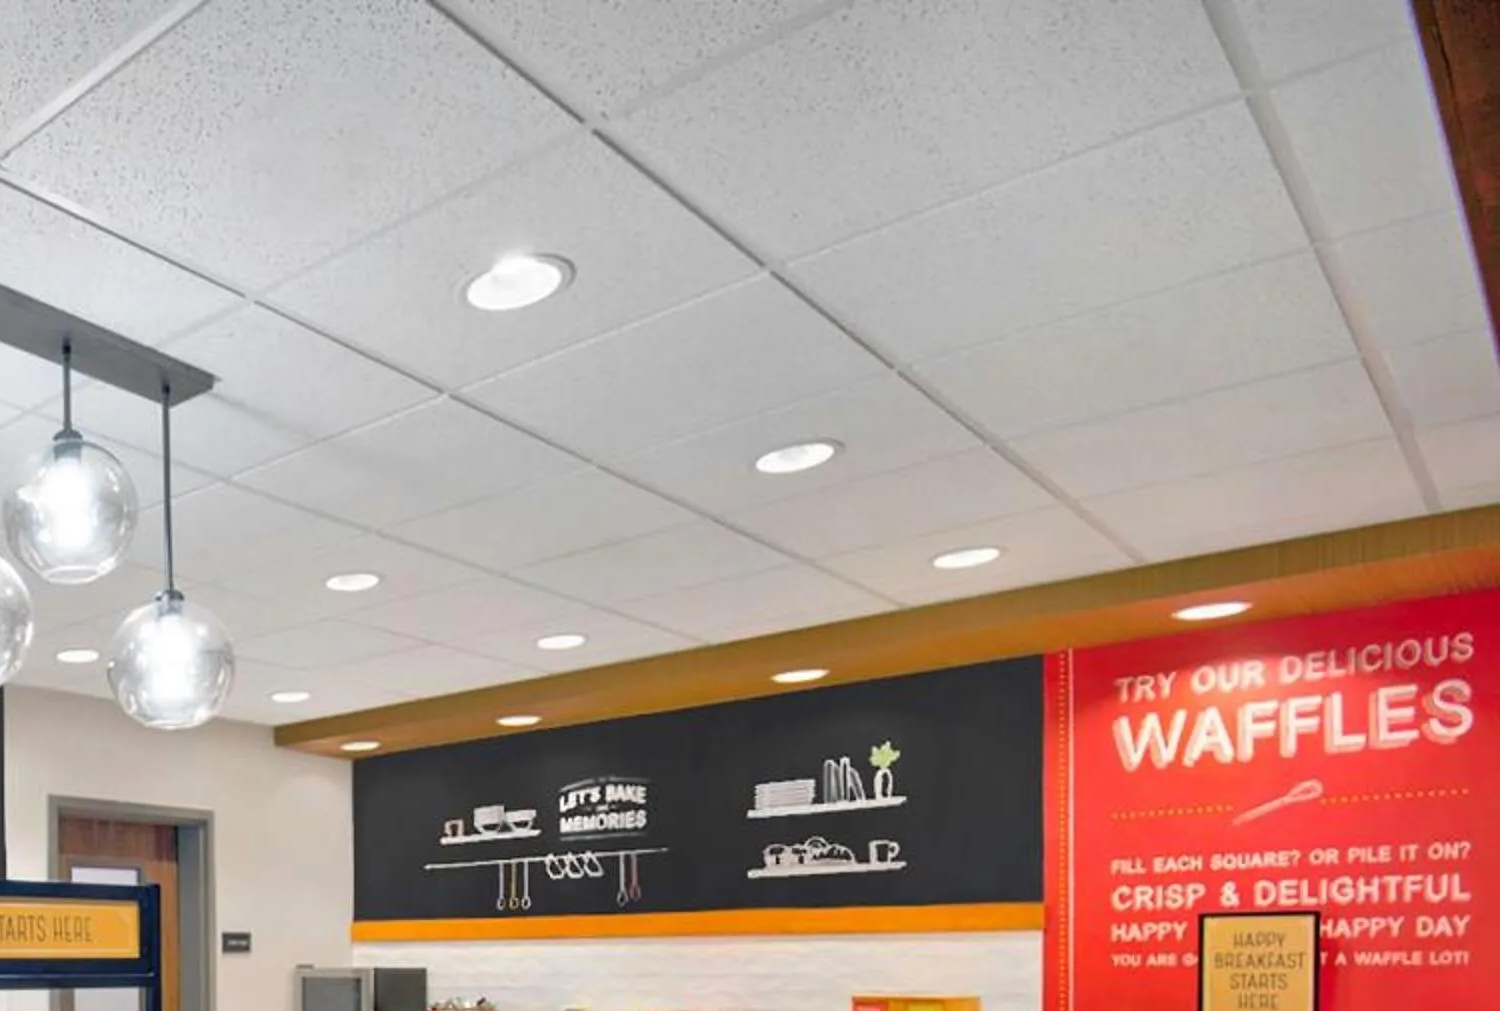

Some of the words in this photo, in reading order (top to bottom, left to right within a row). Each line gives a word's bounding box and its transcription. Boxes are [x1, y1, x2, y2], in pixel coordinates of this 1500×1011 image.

[1114, 671, 1176, 703] TRY
[1190, 660, 1267, 694] OUR
[1279, 631, 1474, 685] DELICIOUS
[1112, 678, 1474, 772] WAFFLES
[559, 809, 647, 833] MEMORIES
[1111, 858, 1146, 875] FILL
[1153, 855, 1203, 873] EACH
[1210, 850, 1300, 871] SQUARE?
[1309, 848, 1339, 865] OR
[1347, 845, 1392, 863] PILE
[1400, 844, 1419, 861] IT
[1427, 841, 1471, 860] ON?
[1111, 884, 1206, 911] CRISP
[1220, 881, 1239, 907] &
[1254, 873, 1471, 907] DELIGHTFUL
[53, 915, 93, 943] HERE
[1111, 921, 1188, 942] HAPPY
[1320, 916, 1404, 938] HAPPY
[1416, 915, 1470, 938] DAY
[1233, 931, 1286, 948] HAPPY
[1112, 953, 1141, 967] YOU
[1146, 953, 1178, 967] ARE
[1335, 952, 1347, 966] A
[1354, 951, 1423, 966] WAFFLE
[1214, 952, 1306, 969] BREAKFAST
[1230, 973, 1288, 990] STARTS
[1238, 993, 1279, 1010] HERE
